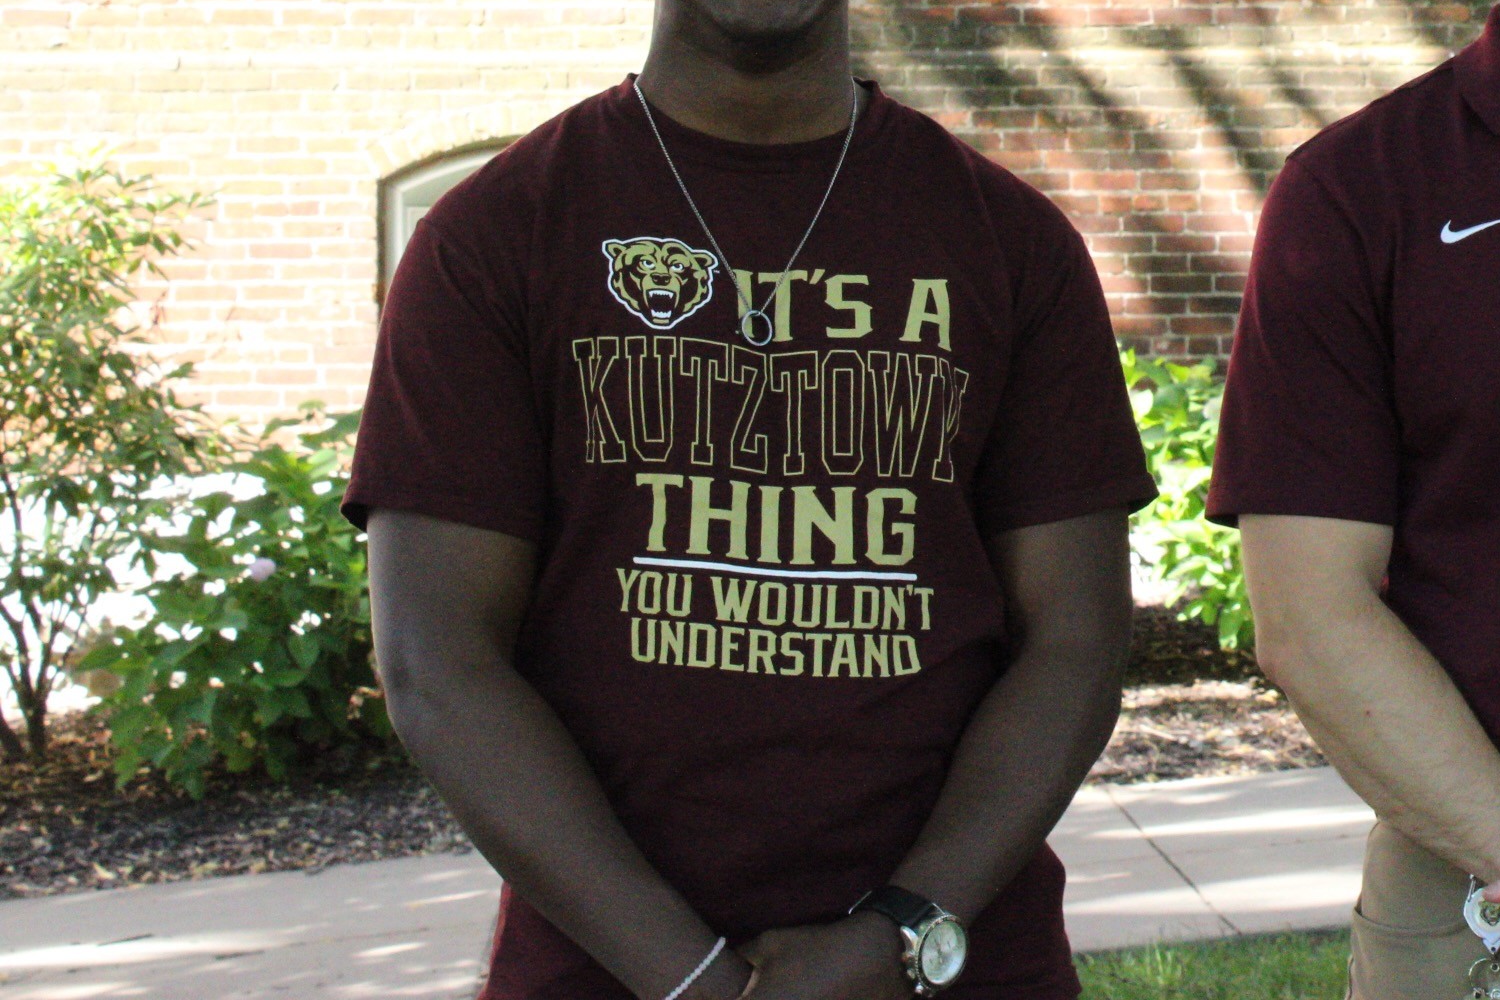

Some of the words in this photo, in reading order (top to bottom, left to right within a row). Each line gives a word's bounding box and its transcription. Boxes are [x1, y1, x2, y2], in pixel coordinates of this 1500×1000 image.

[732, 268, 873, 342] IT'S
[898, 278, 952, 352] A
[635, 472, 918, 566] THING
[616, 568, 694, 617] YOU
[710, 575, 934, 631] WOULDN'T
[630, 617, 922, 678] UNDERSTAND
